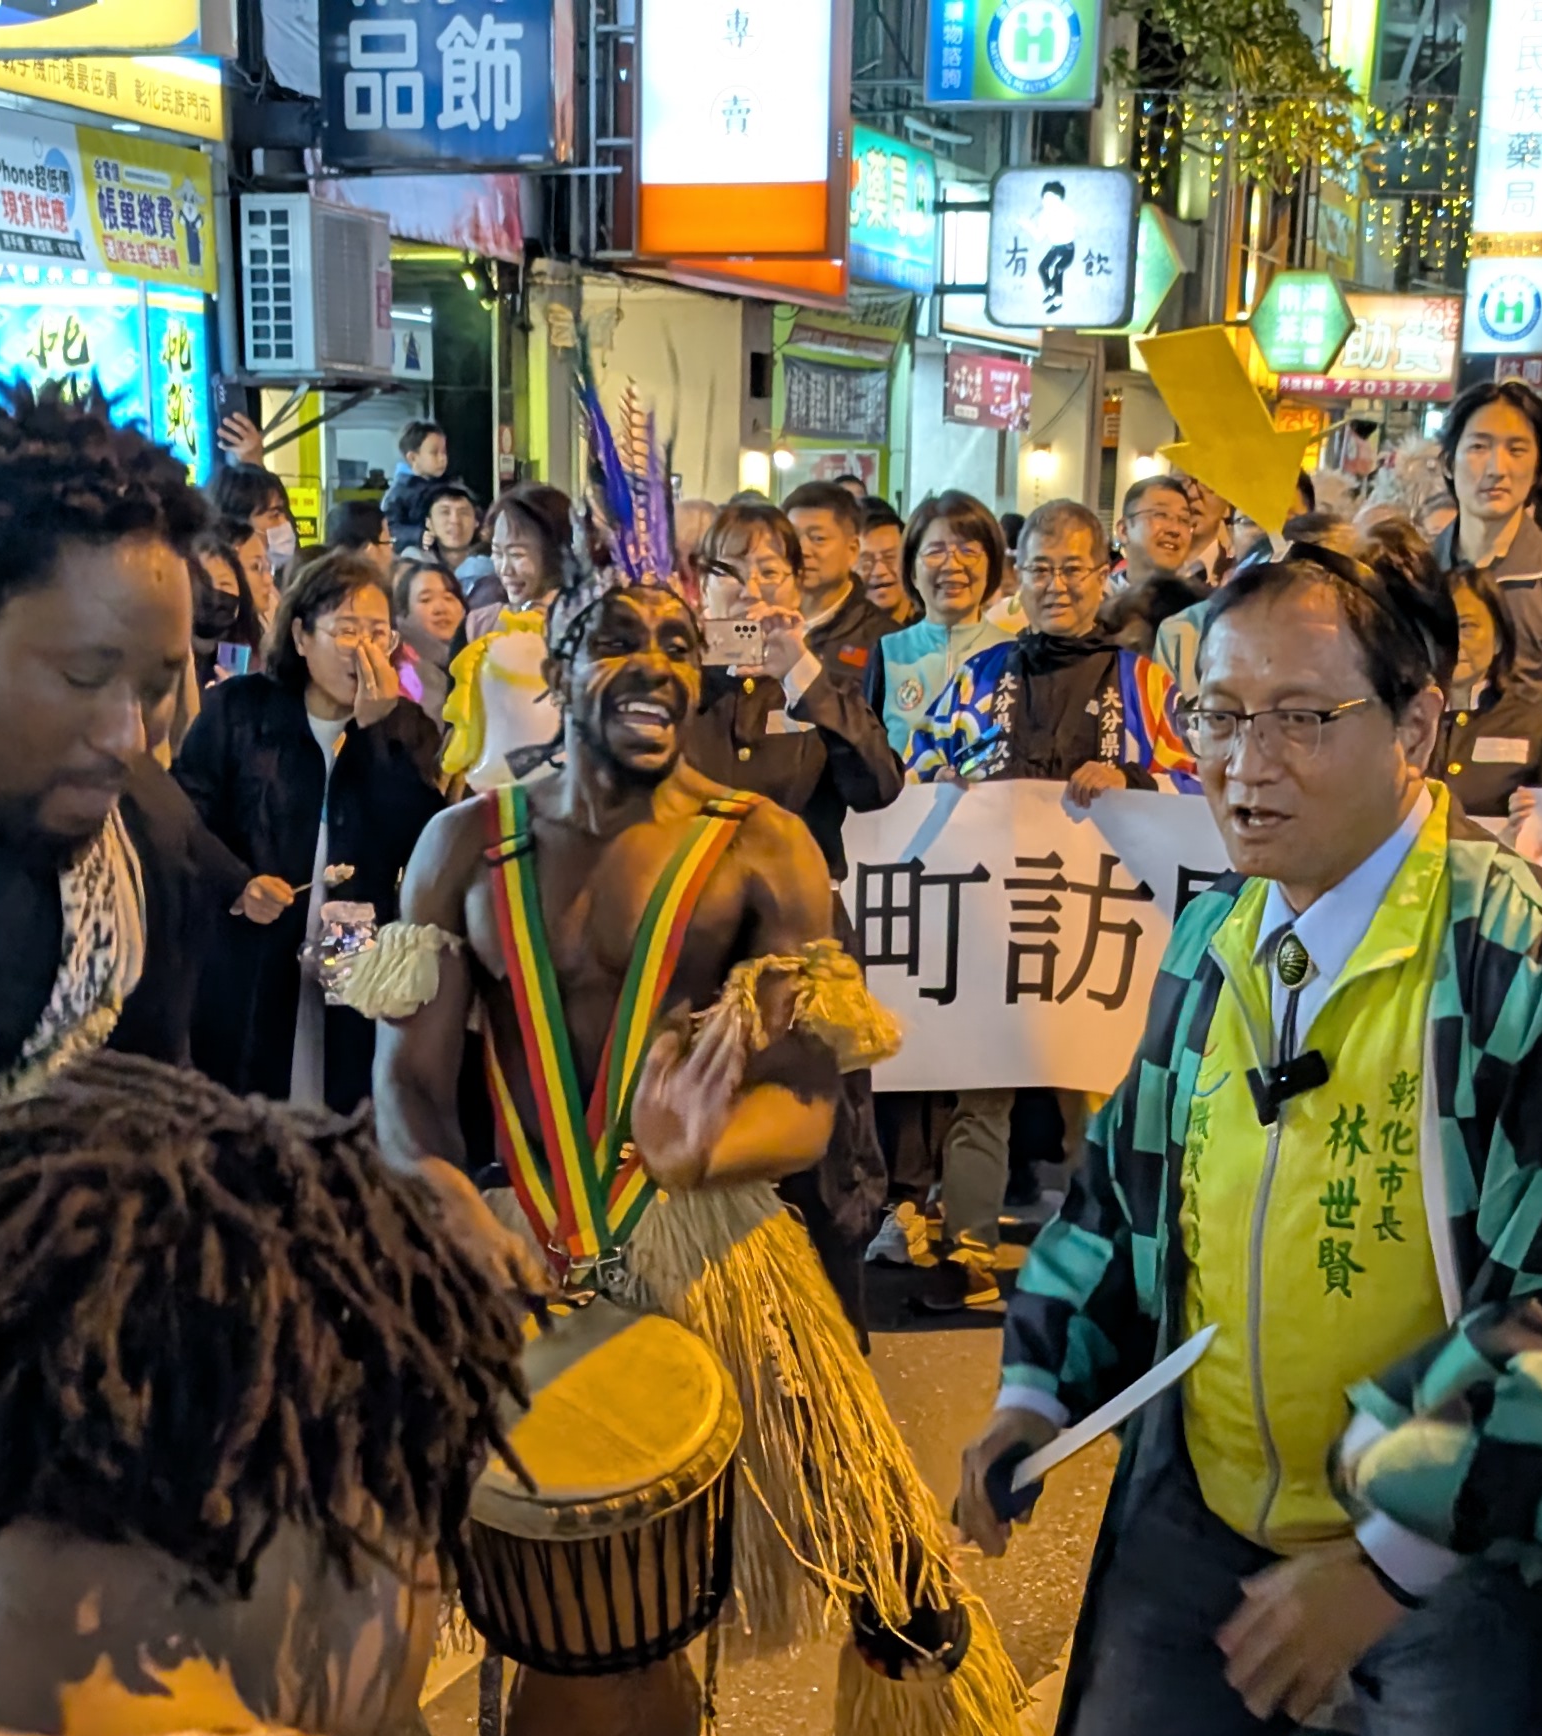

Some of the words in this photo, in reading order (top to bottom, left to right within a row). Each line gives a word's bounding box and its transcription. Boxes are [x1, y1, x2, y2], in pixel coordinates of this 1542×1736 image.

[133, 78, 213, 123] 彰化民族門市
[344, 14, 524, 132] 品飾
[722, 7, 755, 138] 專賣
[0, 188, 70, 234] 現貨供應
[97, 184, 177, 240] 帳單繳費
[1004, 236, 1029, 277] 有
[1083, 248, 1114, 277] 飲
[1333, 380, 1439, 398] 7203277
[1100, 686, 1124, 771] 大分県
[857, 849, 1235, 1011] 町訪
[1373, 1070, 1420, 1243] 彰化市長
[1318, 1103, 1372, 1299] 林世賢
